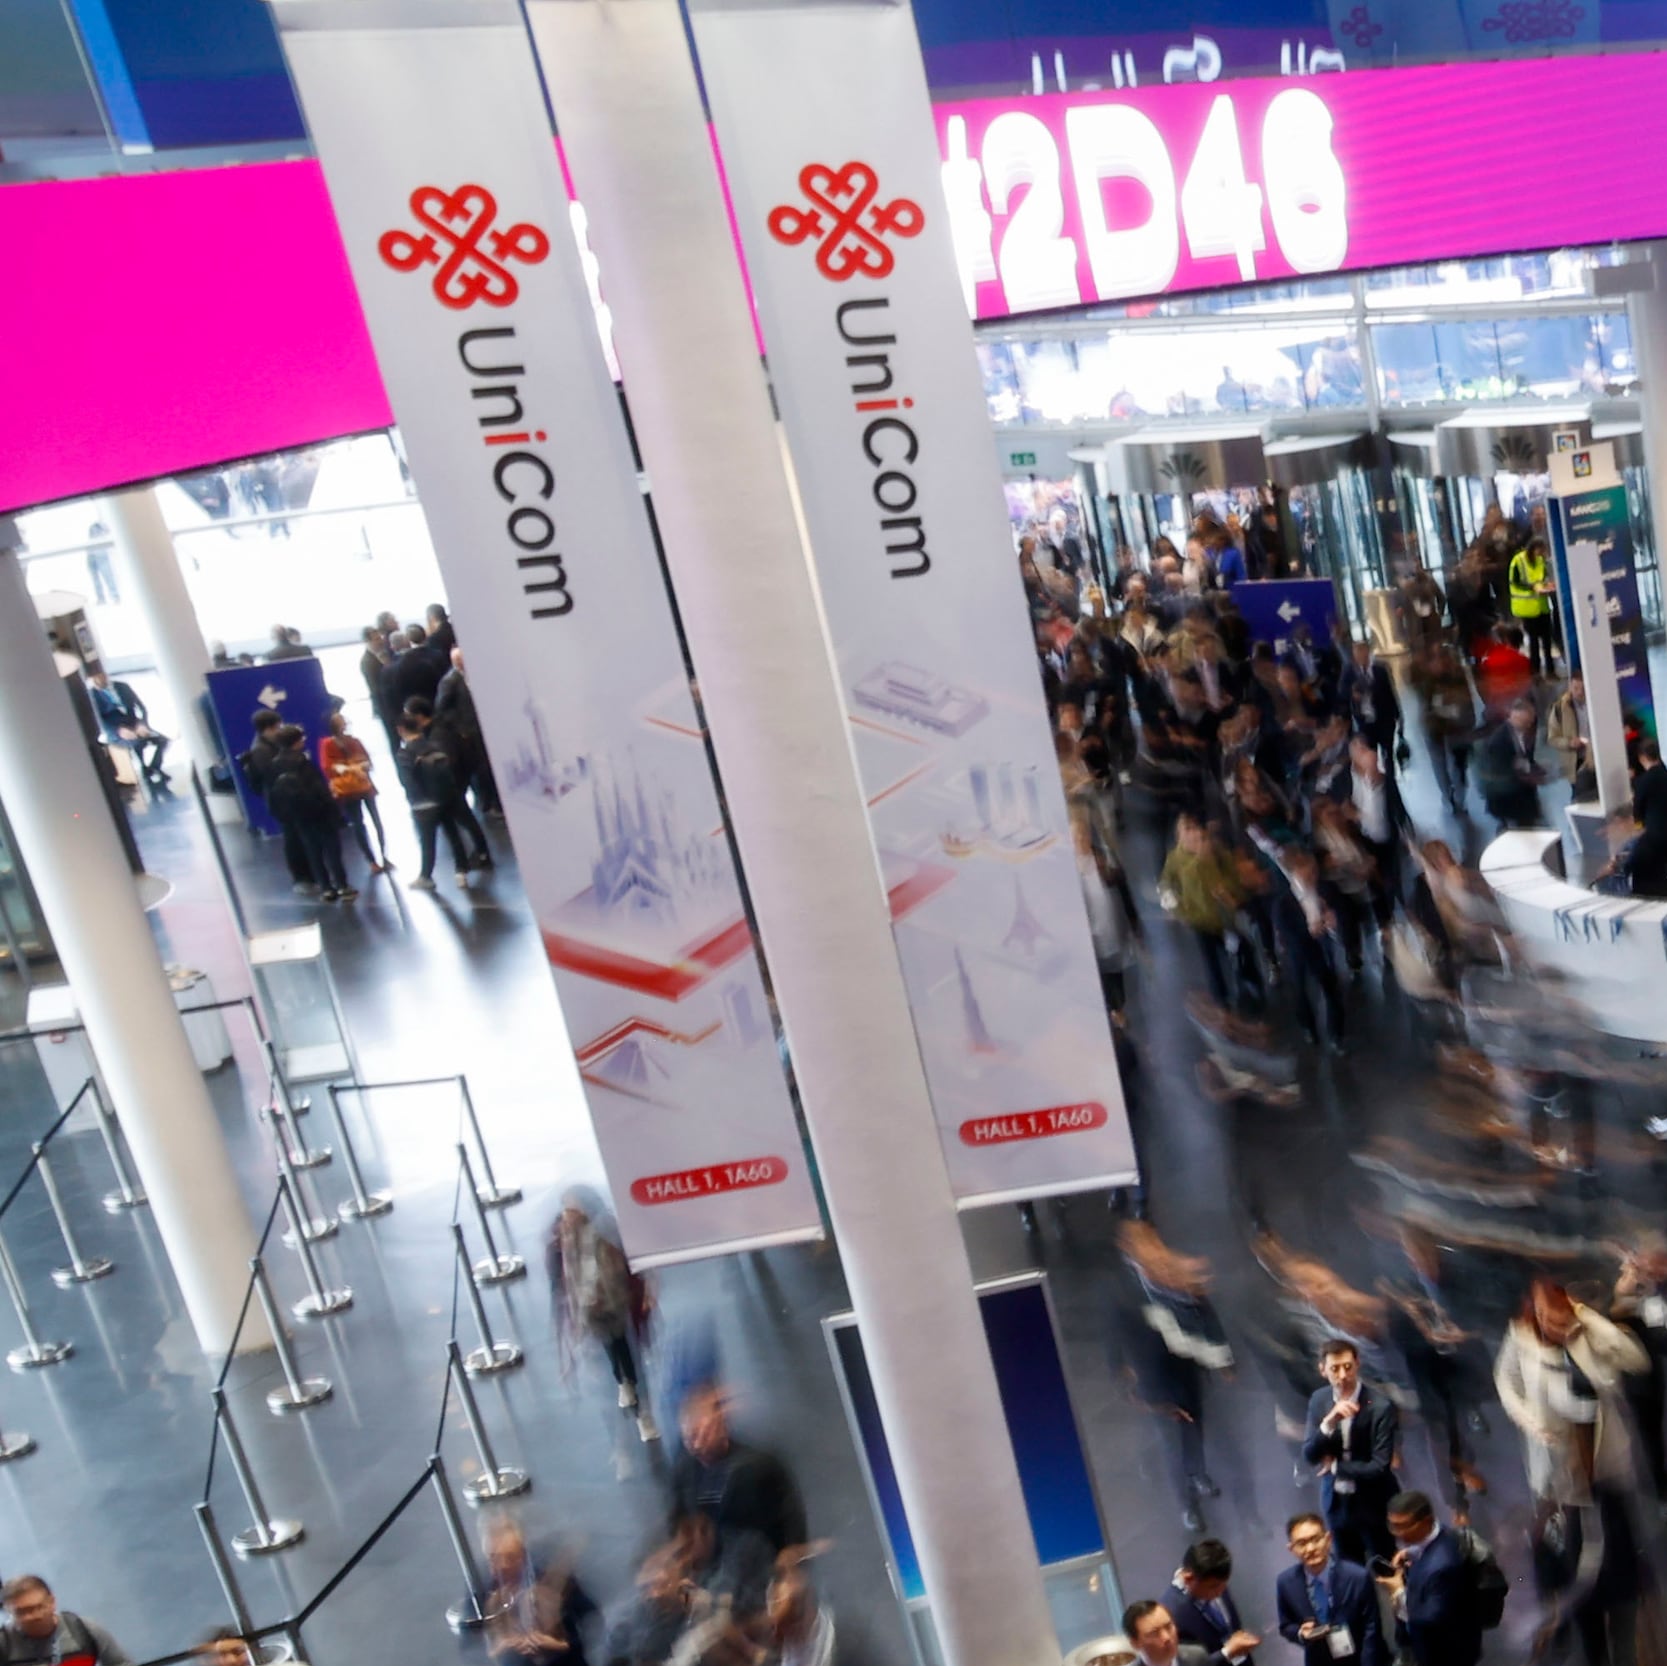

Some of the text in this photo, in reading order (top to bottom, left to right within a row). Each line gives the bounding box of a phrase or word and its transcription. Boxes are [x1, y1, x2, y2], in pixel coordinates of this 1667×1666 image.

[974, 1107, 1093, 1140] HALL 1, 1A60
[646, 1162, 772, 1198] HALL 1, 1A60
